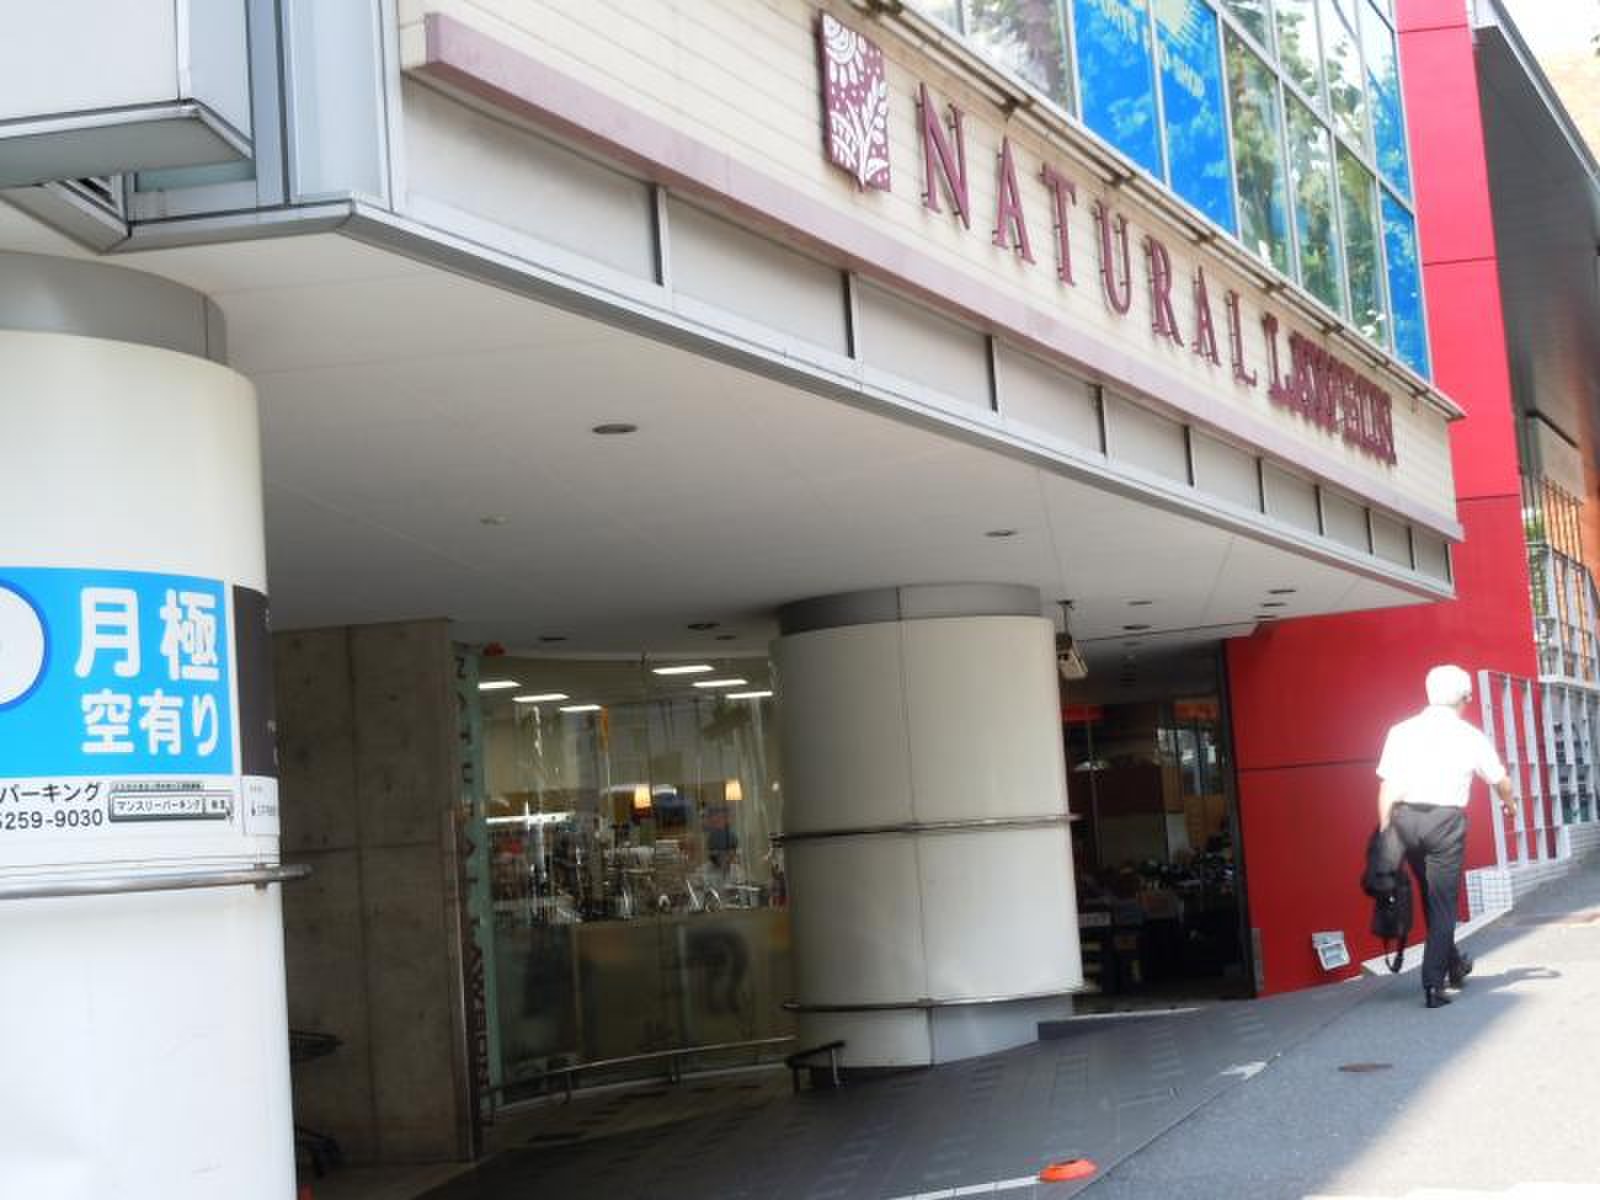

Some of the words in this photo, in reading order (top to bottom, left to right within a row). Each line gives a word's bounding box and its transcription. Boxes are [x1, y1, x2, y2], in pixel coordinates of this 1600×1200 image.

[916, 82, 1257, 387] NATURAL
[74, 587, 219, 681] 月極
[81, 688, 218, 756] 空有り
[0, 808, 103, 830] 259-9030
